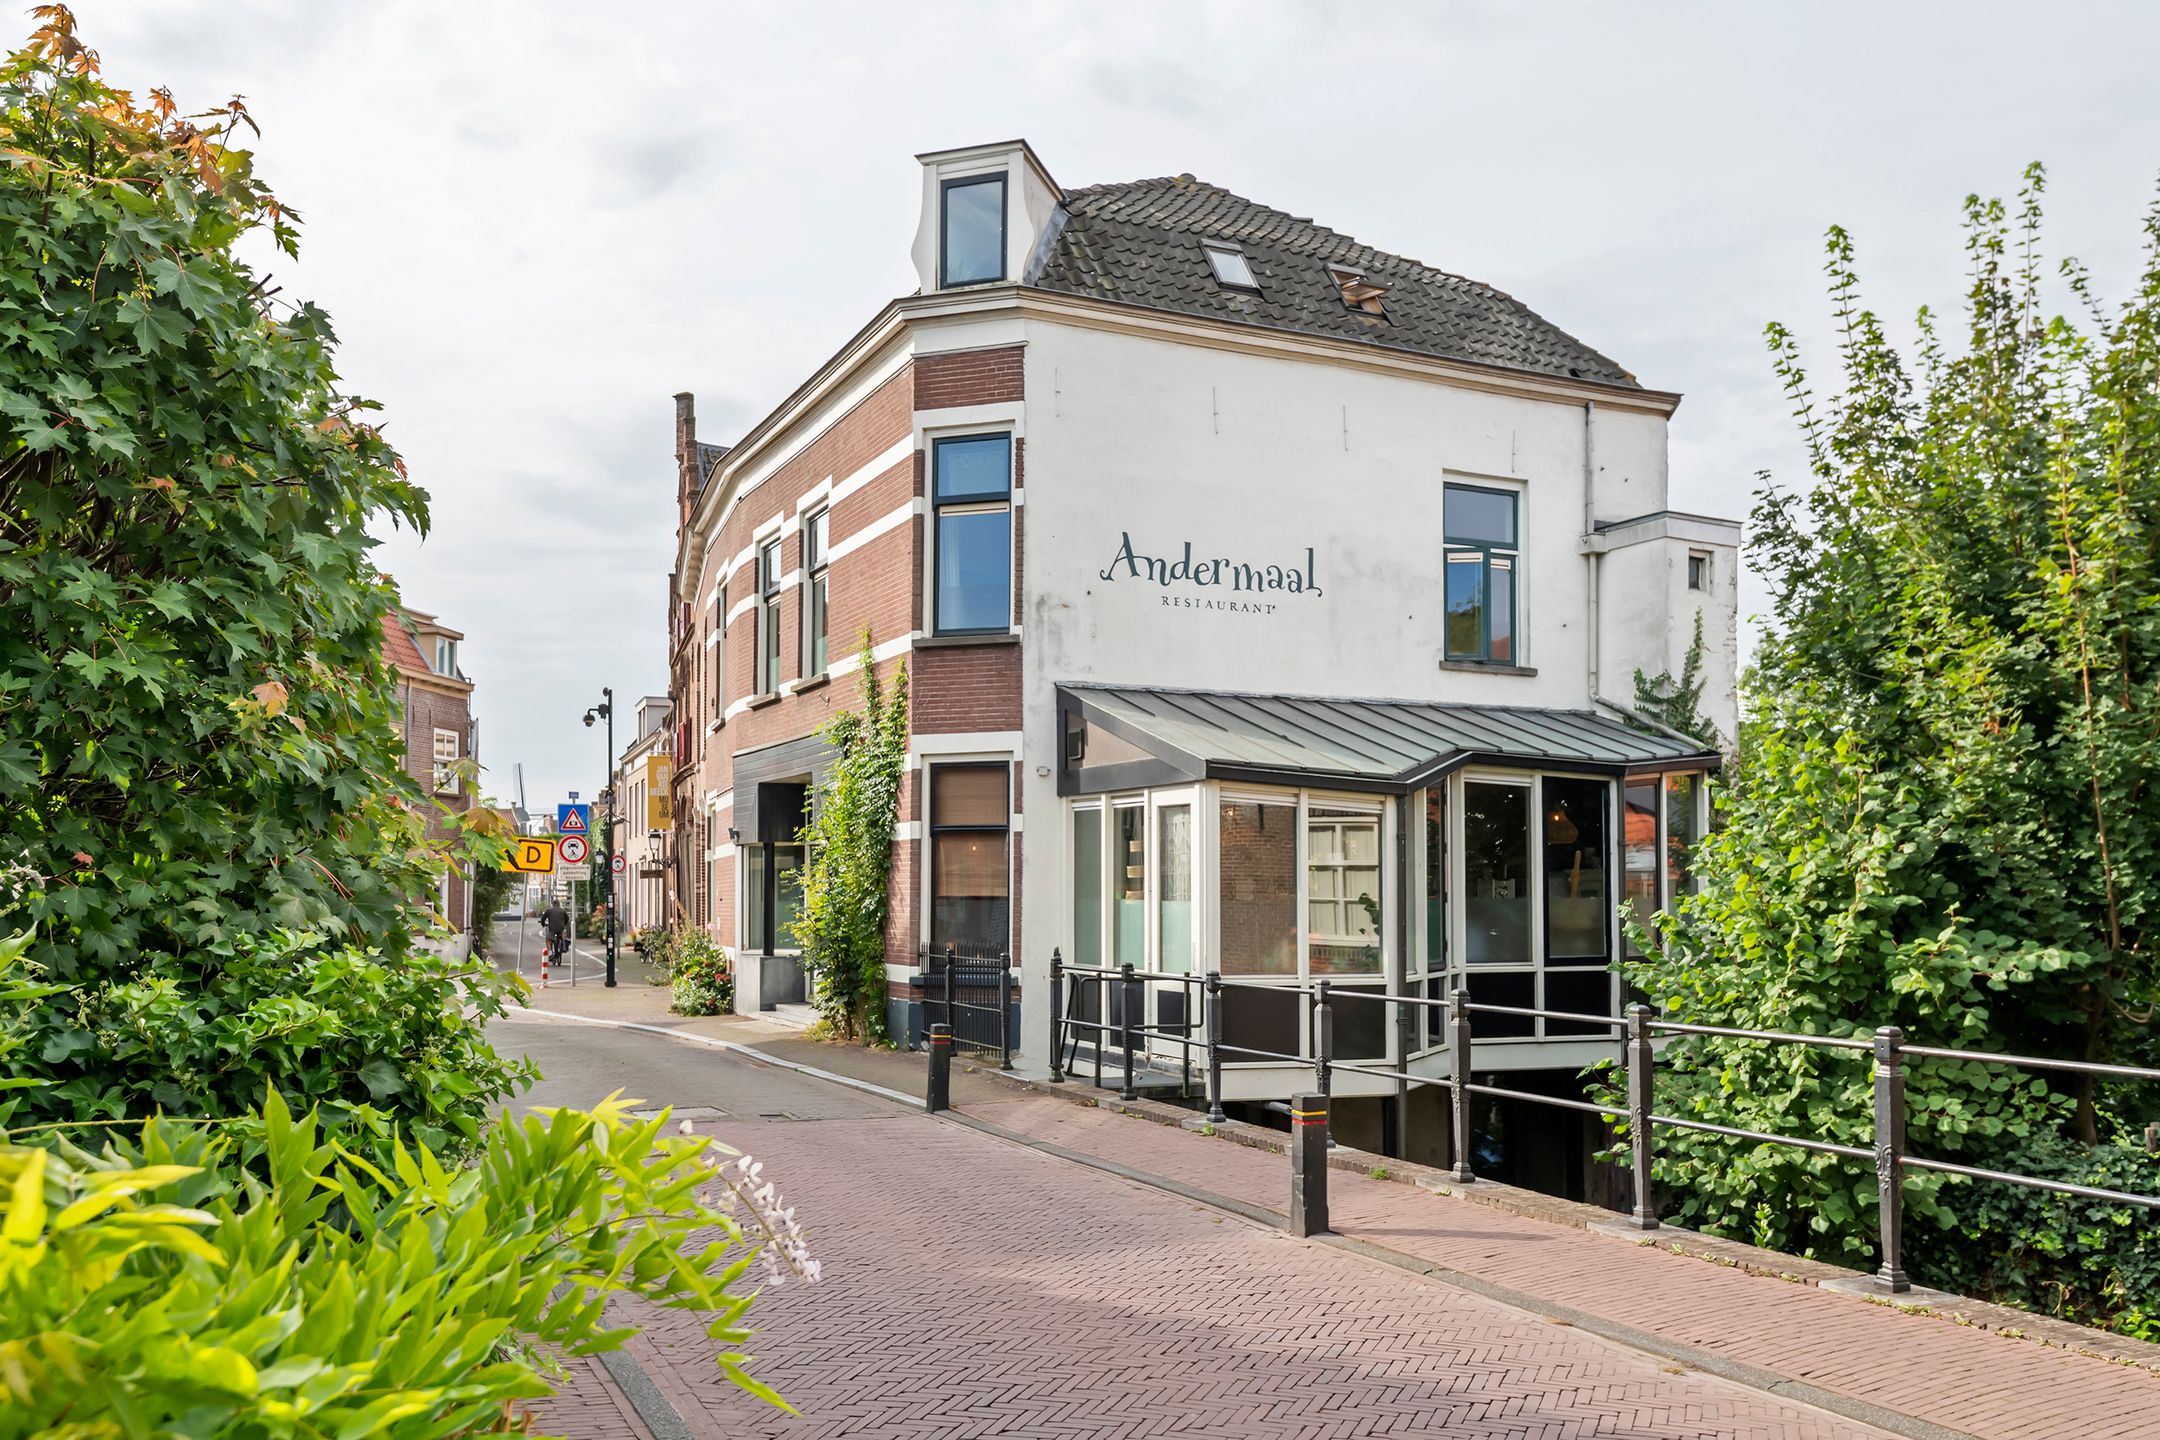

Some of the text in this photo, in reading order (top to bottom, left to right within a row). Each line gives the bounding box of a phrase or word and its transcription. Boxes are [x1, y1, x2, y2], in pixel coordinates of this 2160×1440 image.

[1099, 531, 1323, 598] Andermaal
[1161, 595, 1272, 615] RESTAURANT
[526, 846, 541, 863] D
